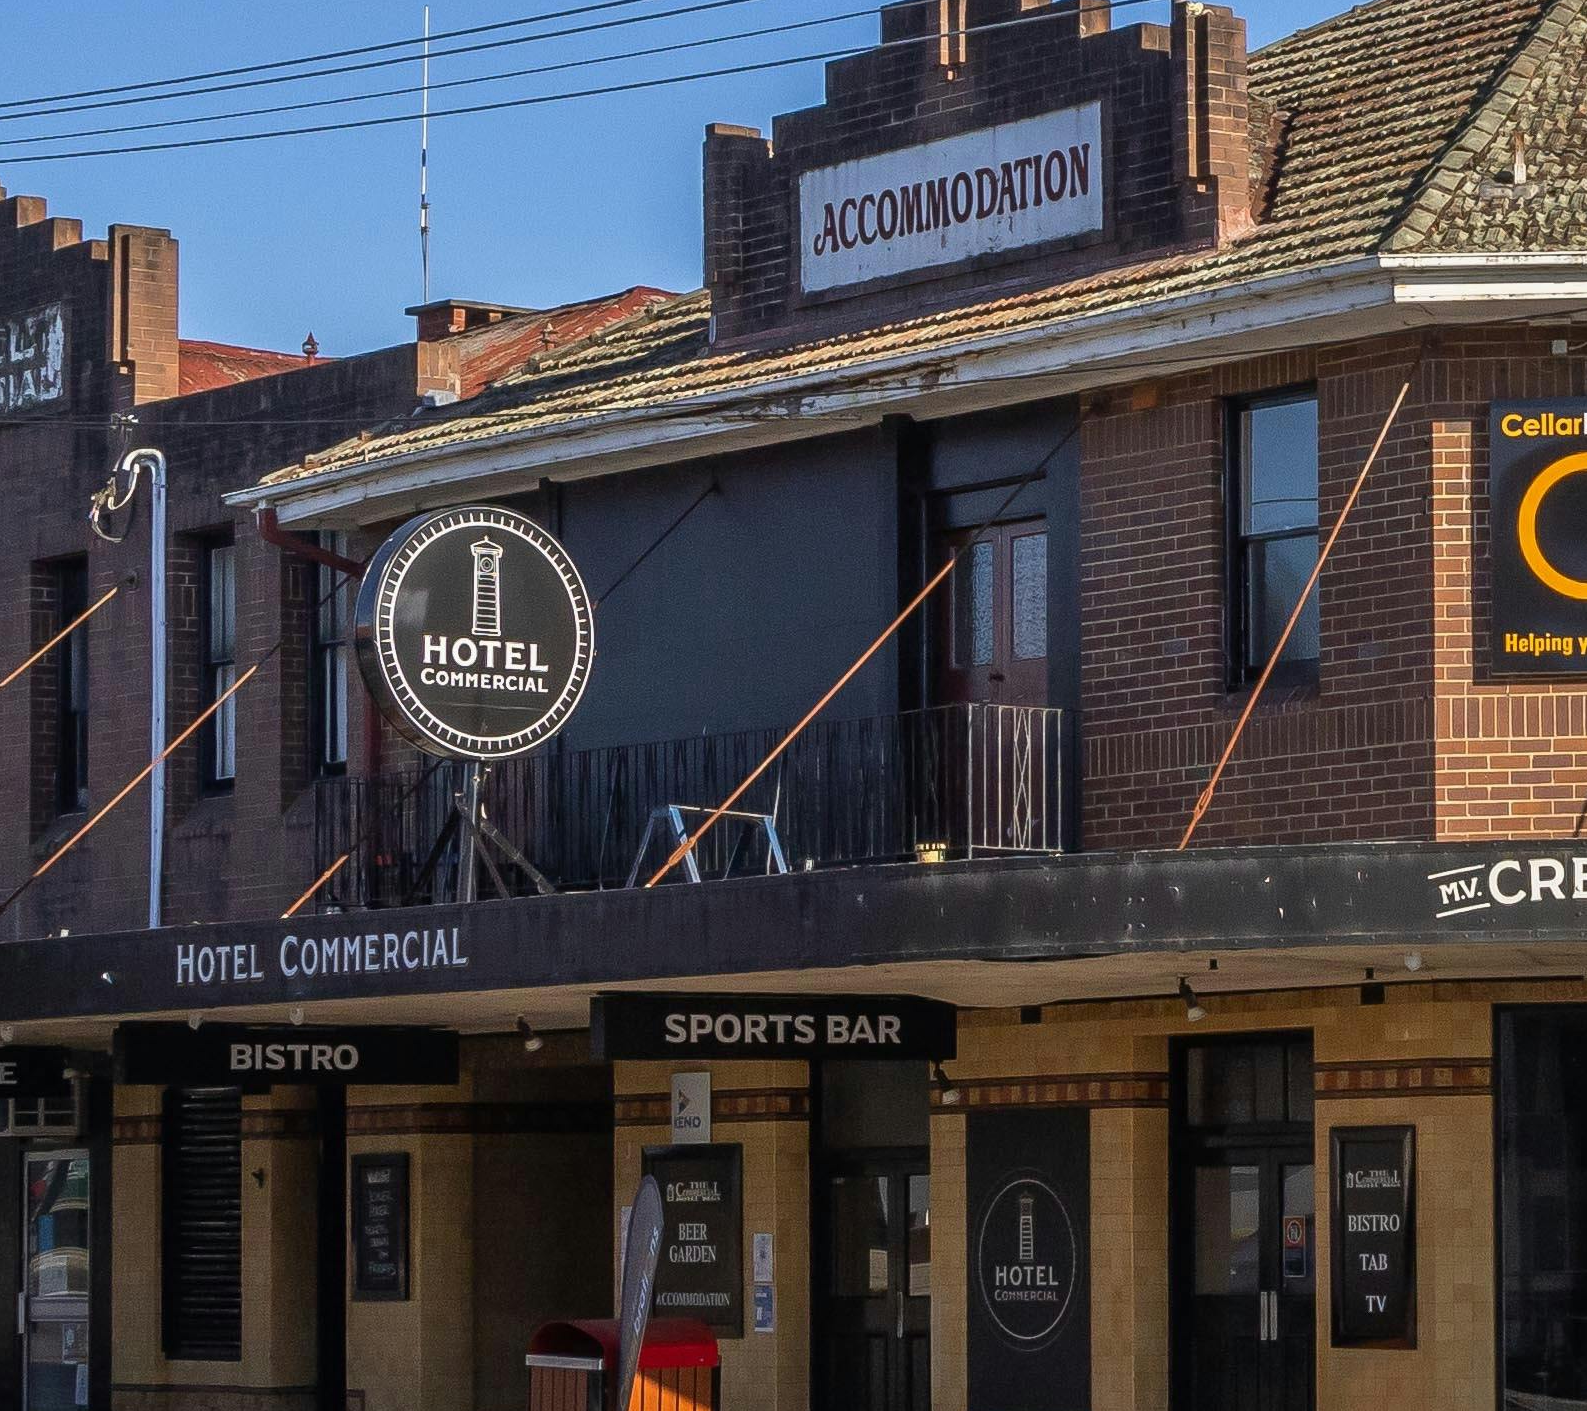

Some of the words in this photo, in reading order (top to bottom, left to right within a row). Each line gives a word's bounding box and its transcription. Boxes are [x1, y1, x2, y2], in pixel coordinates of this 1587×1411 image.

[813, 142, 1091, 256] ACCOMMODATION
[422, 635, 549, 672] HOTEL
[1505, 632, 1573, 655] Helping
[420, 667, 549, 693] COMMERCIAL
[1438, 877, 1482, 905] M.V.
[176, 943, 263, 984] HOTEL
[279, 927, 469, 977] COMMERCIAL
[665, 1013, 816, 1044] SPORTS
[826, 1014, 902, 1044] BAR
[230, 1043, 360, 1070] BISTRO
[678, 1223, 708, 1242] BEER
[1347, 1213, 1400, 1232] BISTRO
[668, 1245, 717, 1264] GARDEN
[1359, 1253, 1389, 1271] TAB
[995, 1265, 1059, 1286] HOTEL
[655, 1291, 732, 1307] ACCOMMODATION
[994, 1289, 1060, 1301] COMMERCIAL
[1365, 1295, 1387, 1313] TV
